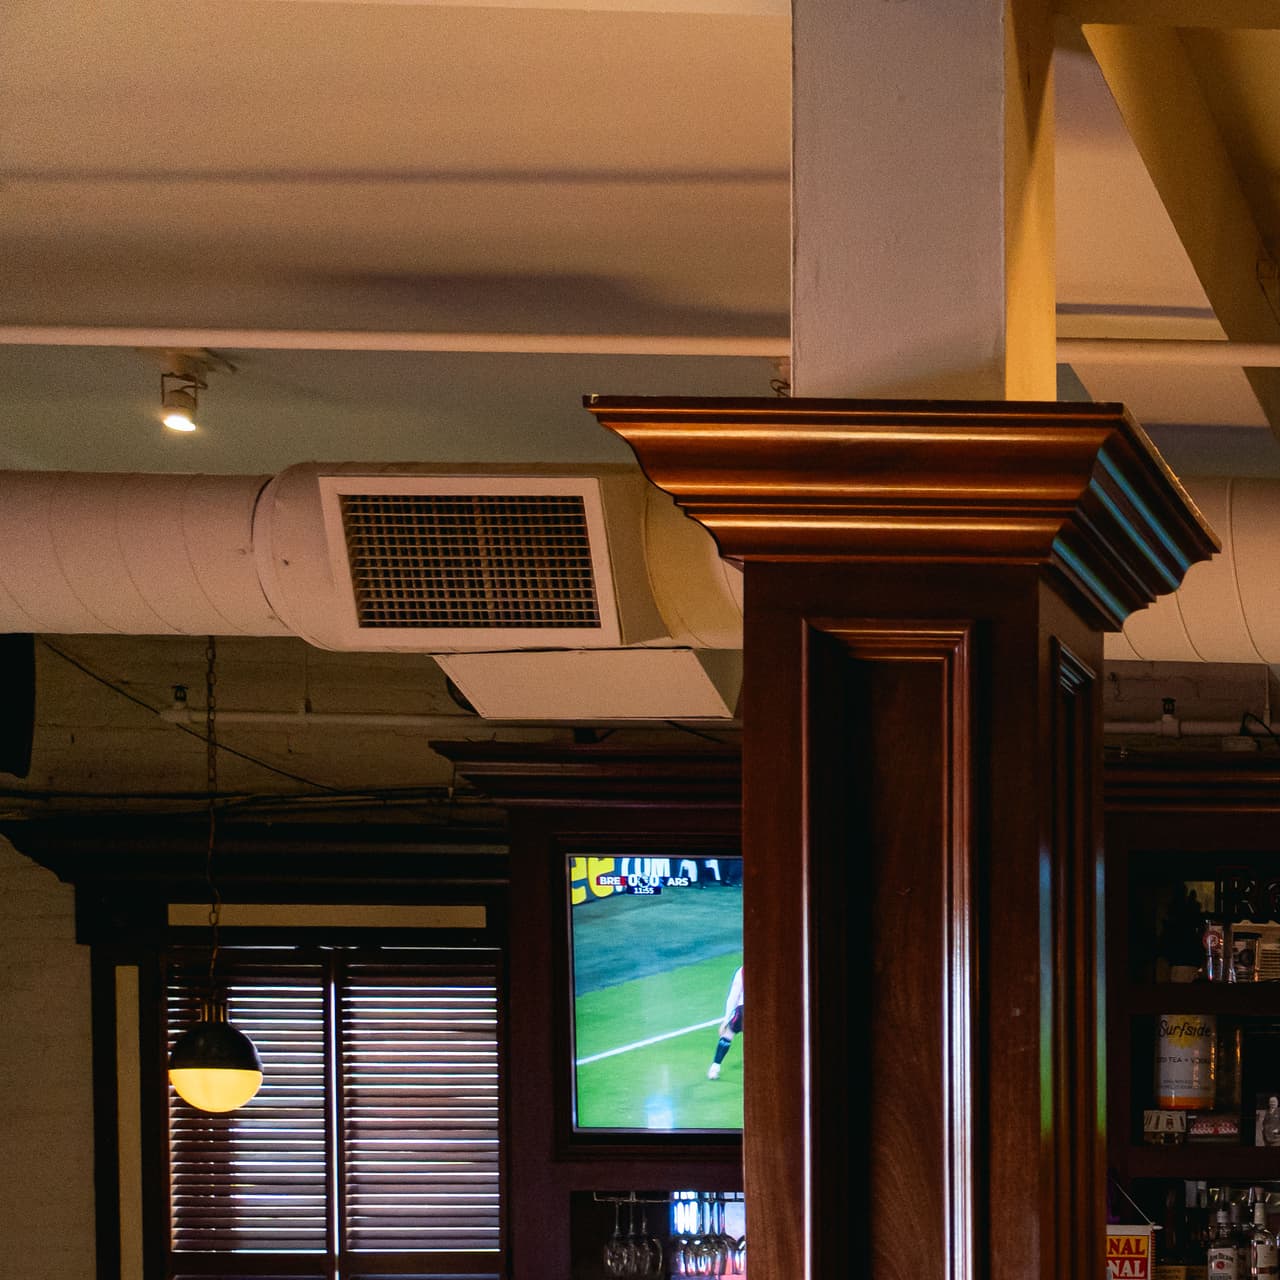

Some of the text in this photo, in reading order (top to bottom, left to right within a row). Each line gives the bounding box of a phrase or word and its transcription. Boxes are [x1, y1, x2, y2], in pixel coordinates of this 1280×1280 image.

[599, 876, 620, 885] BRE
[667, 877, 689, 886] ARS
[1159, 1020, 1210, 1038] Surfside
